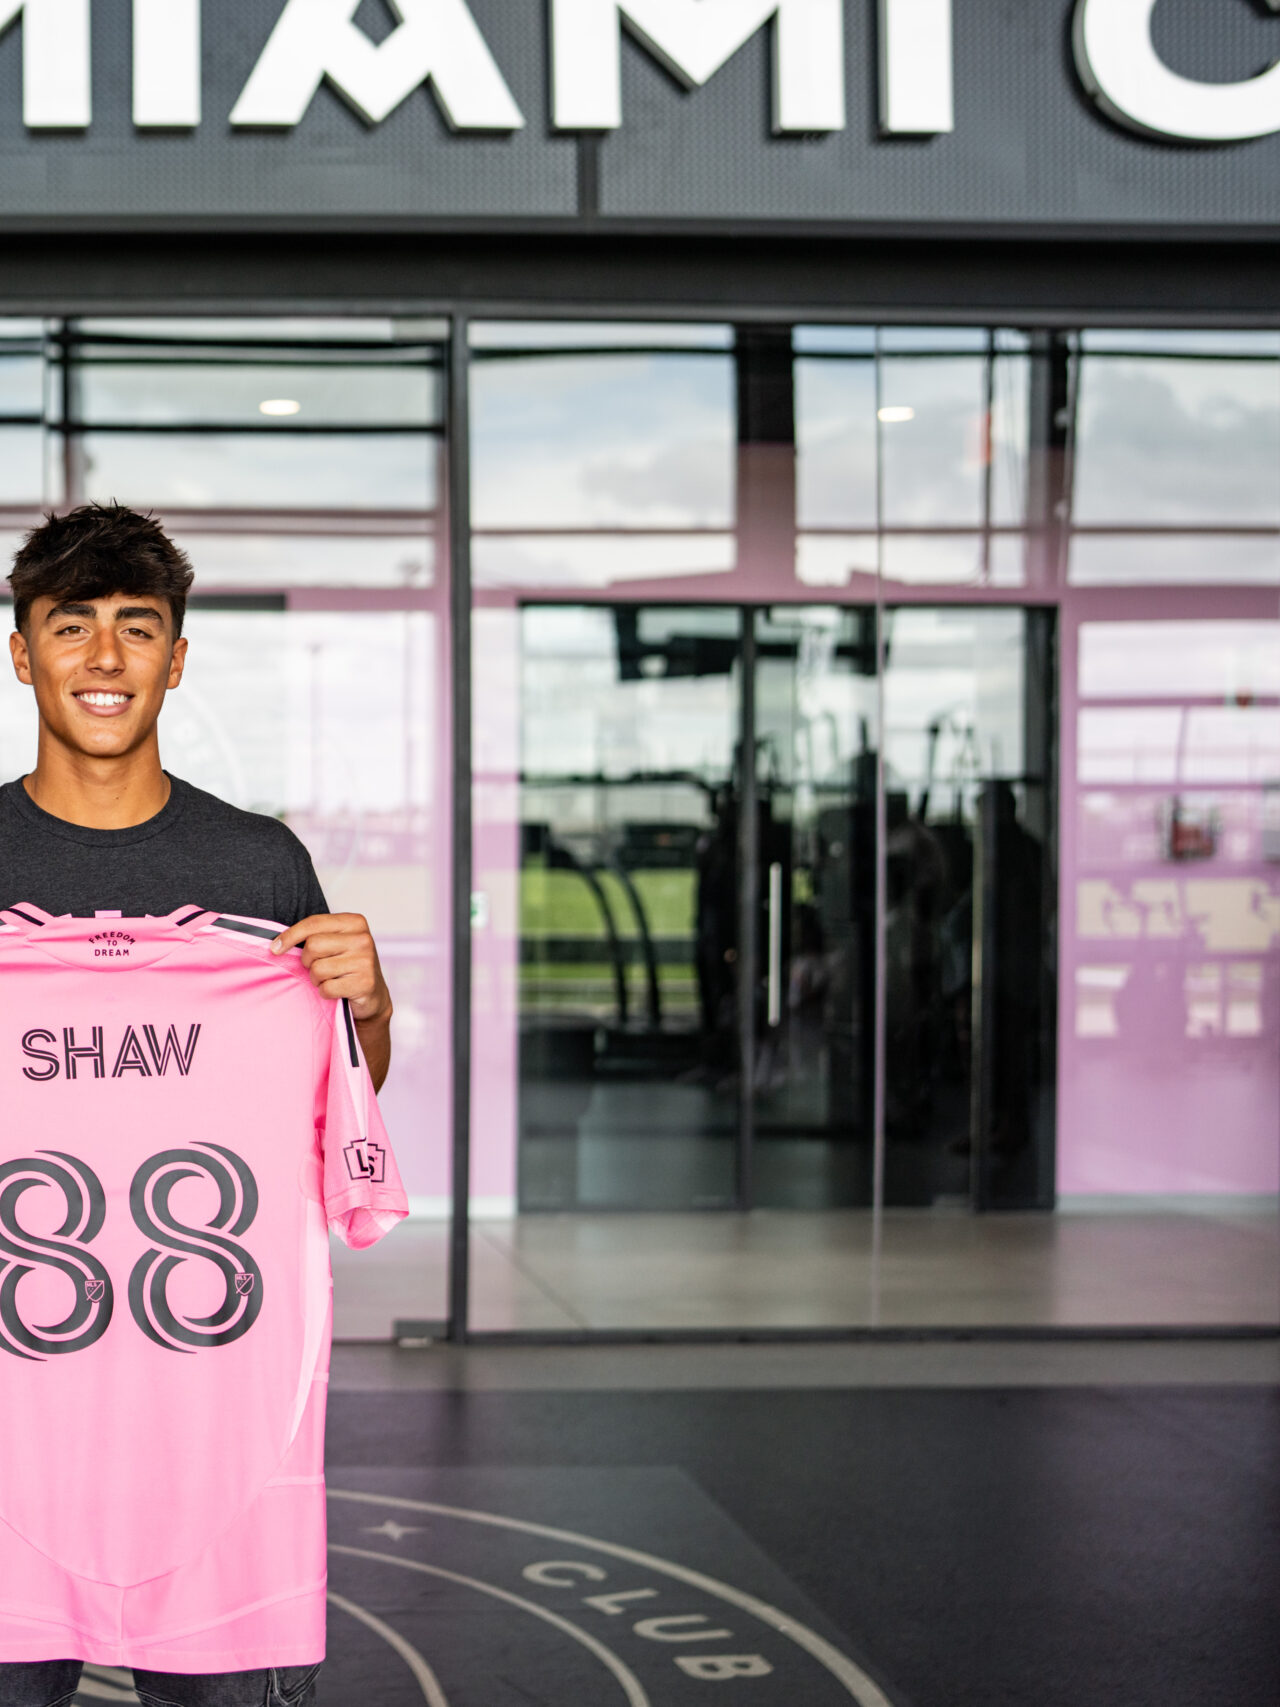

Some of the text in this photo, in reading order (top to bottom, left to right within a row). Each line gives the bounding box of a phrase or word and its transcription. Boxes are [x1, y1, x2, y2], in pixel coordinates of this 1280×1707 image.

[88, 931, 136, 945] FREEDOM
[106, 939, 118, 947] TO
[94, 948, 130, 957] DREAM
[21, 1023, 202, 1082] SHAW
[521, 1560, 774, 1680] CLUB
